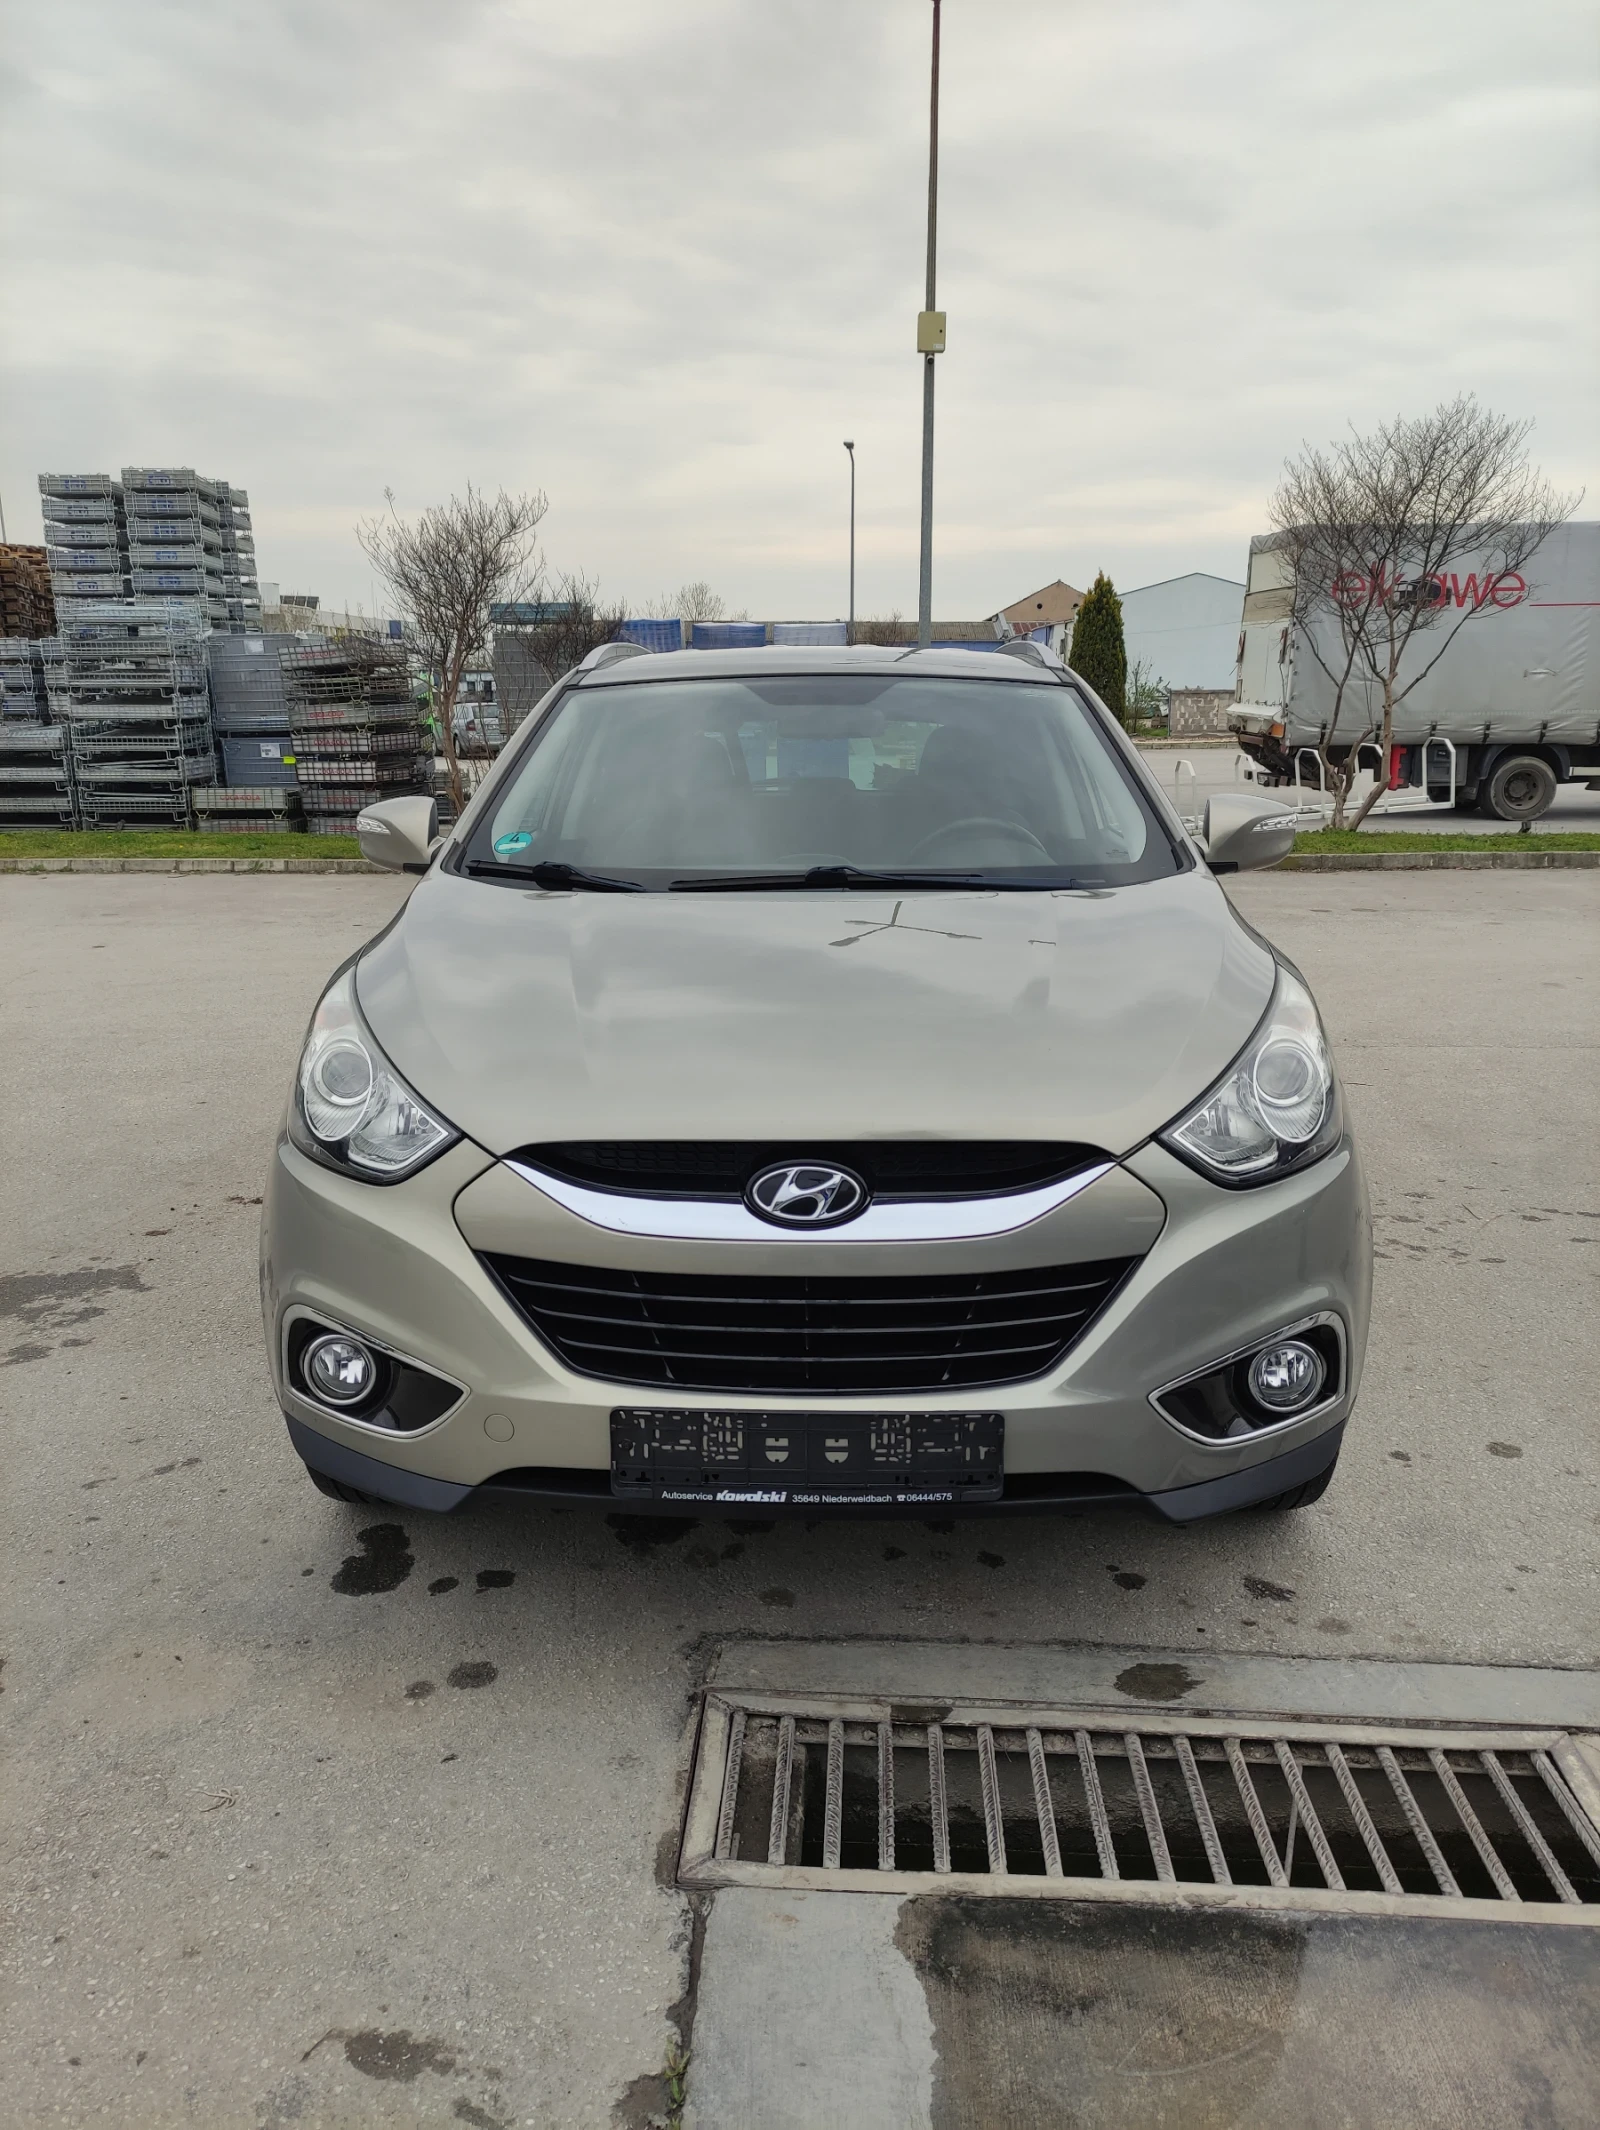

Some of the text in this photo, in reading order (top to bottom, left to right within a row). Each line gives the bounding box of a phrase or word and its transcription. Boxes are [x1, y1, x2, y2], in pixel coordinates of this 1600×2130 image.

[509, 833, 520, 844] 4
[661, 1489, 953, 1503] Autoservice Kowalski 35649 Niederweidbach 06444/575
